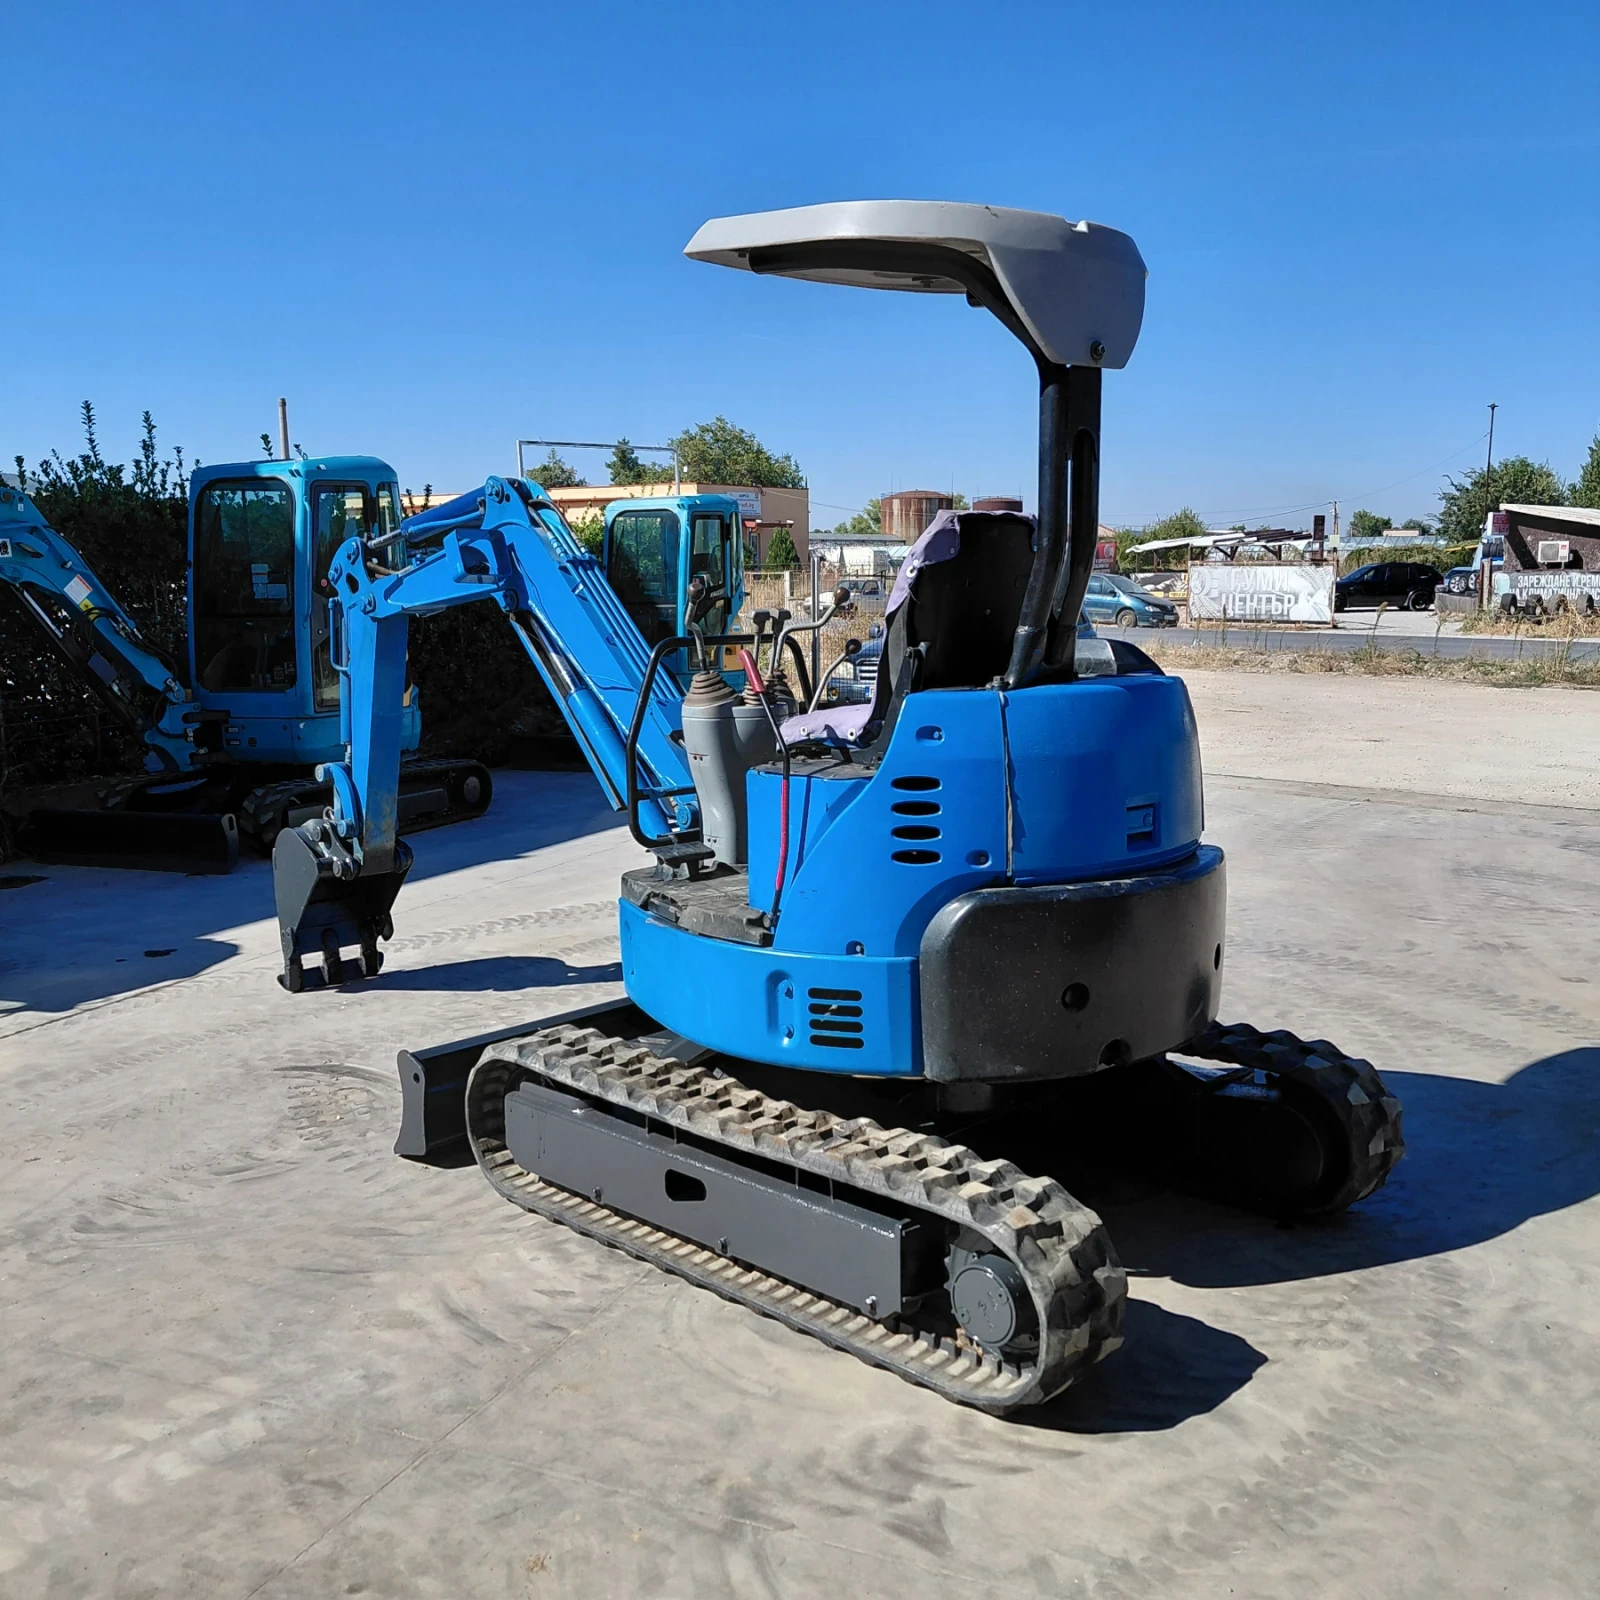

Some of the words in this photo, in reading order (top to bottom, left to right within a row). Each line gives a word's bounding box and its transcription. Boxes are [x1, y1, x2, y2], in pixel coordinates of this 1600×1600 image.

[1230, 567, 1288, 591] ГУМИ
[1518, 574, 1571, 588] ЗАРЕЖДАНЕ
[1221, 593, 1295, 616] ЦЕНТЪР
